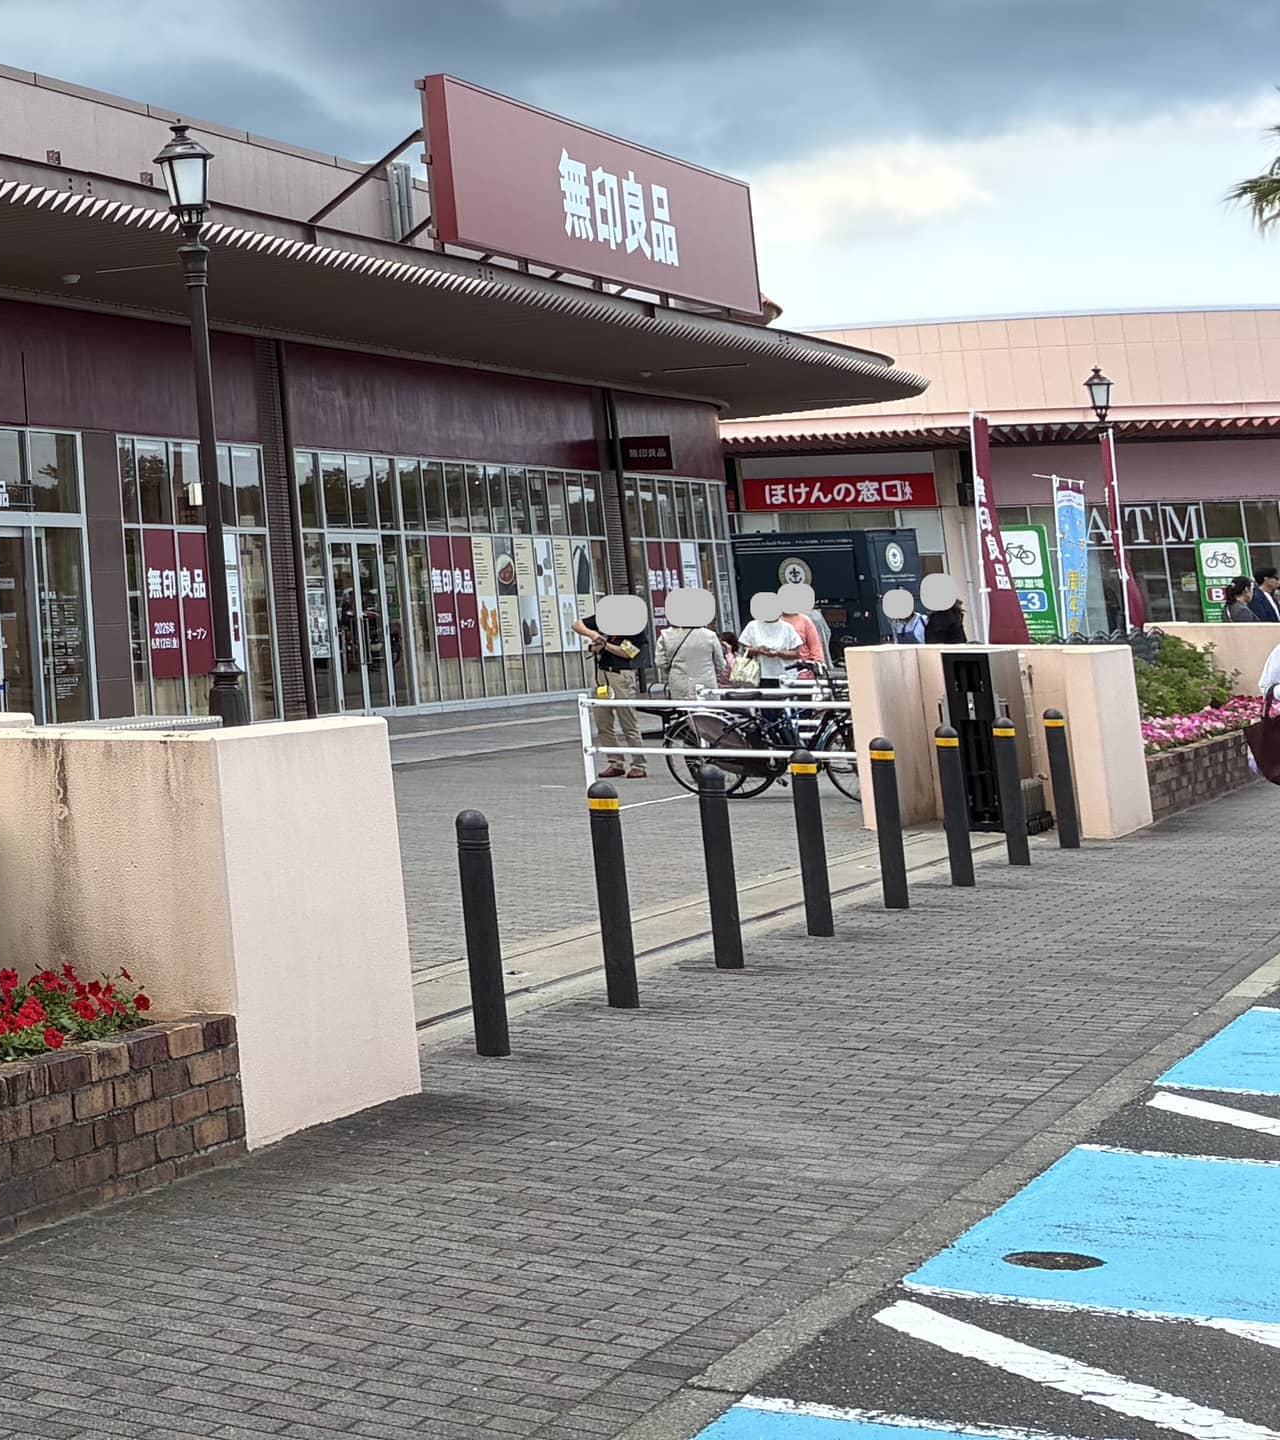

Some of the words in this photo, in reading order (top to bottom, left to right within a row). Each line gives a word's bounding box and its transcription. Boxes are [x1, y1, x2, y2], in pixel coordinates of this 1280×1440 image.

[559, 148, 679, 267] 無印良品
[765, 480, 903, 504] ほけんの窓口
[1087, 506, 1200, 544] ATM
[147, 567, 206, 599] 無印良品
[431, 567, 474, 594] 無印良品
[1019, 592, 1041, 610] -3
